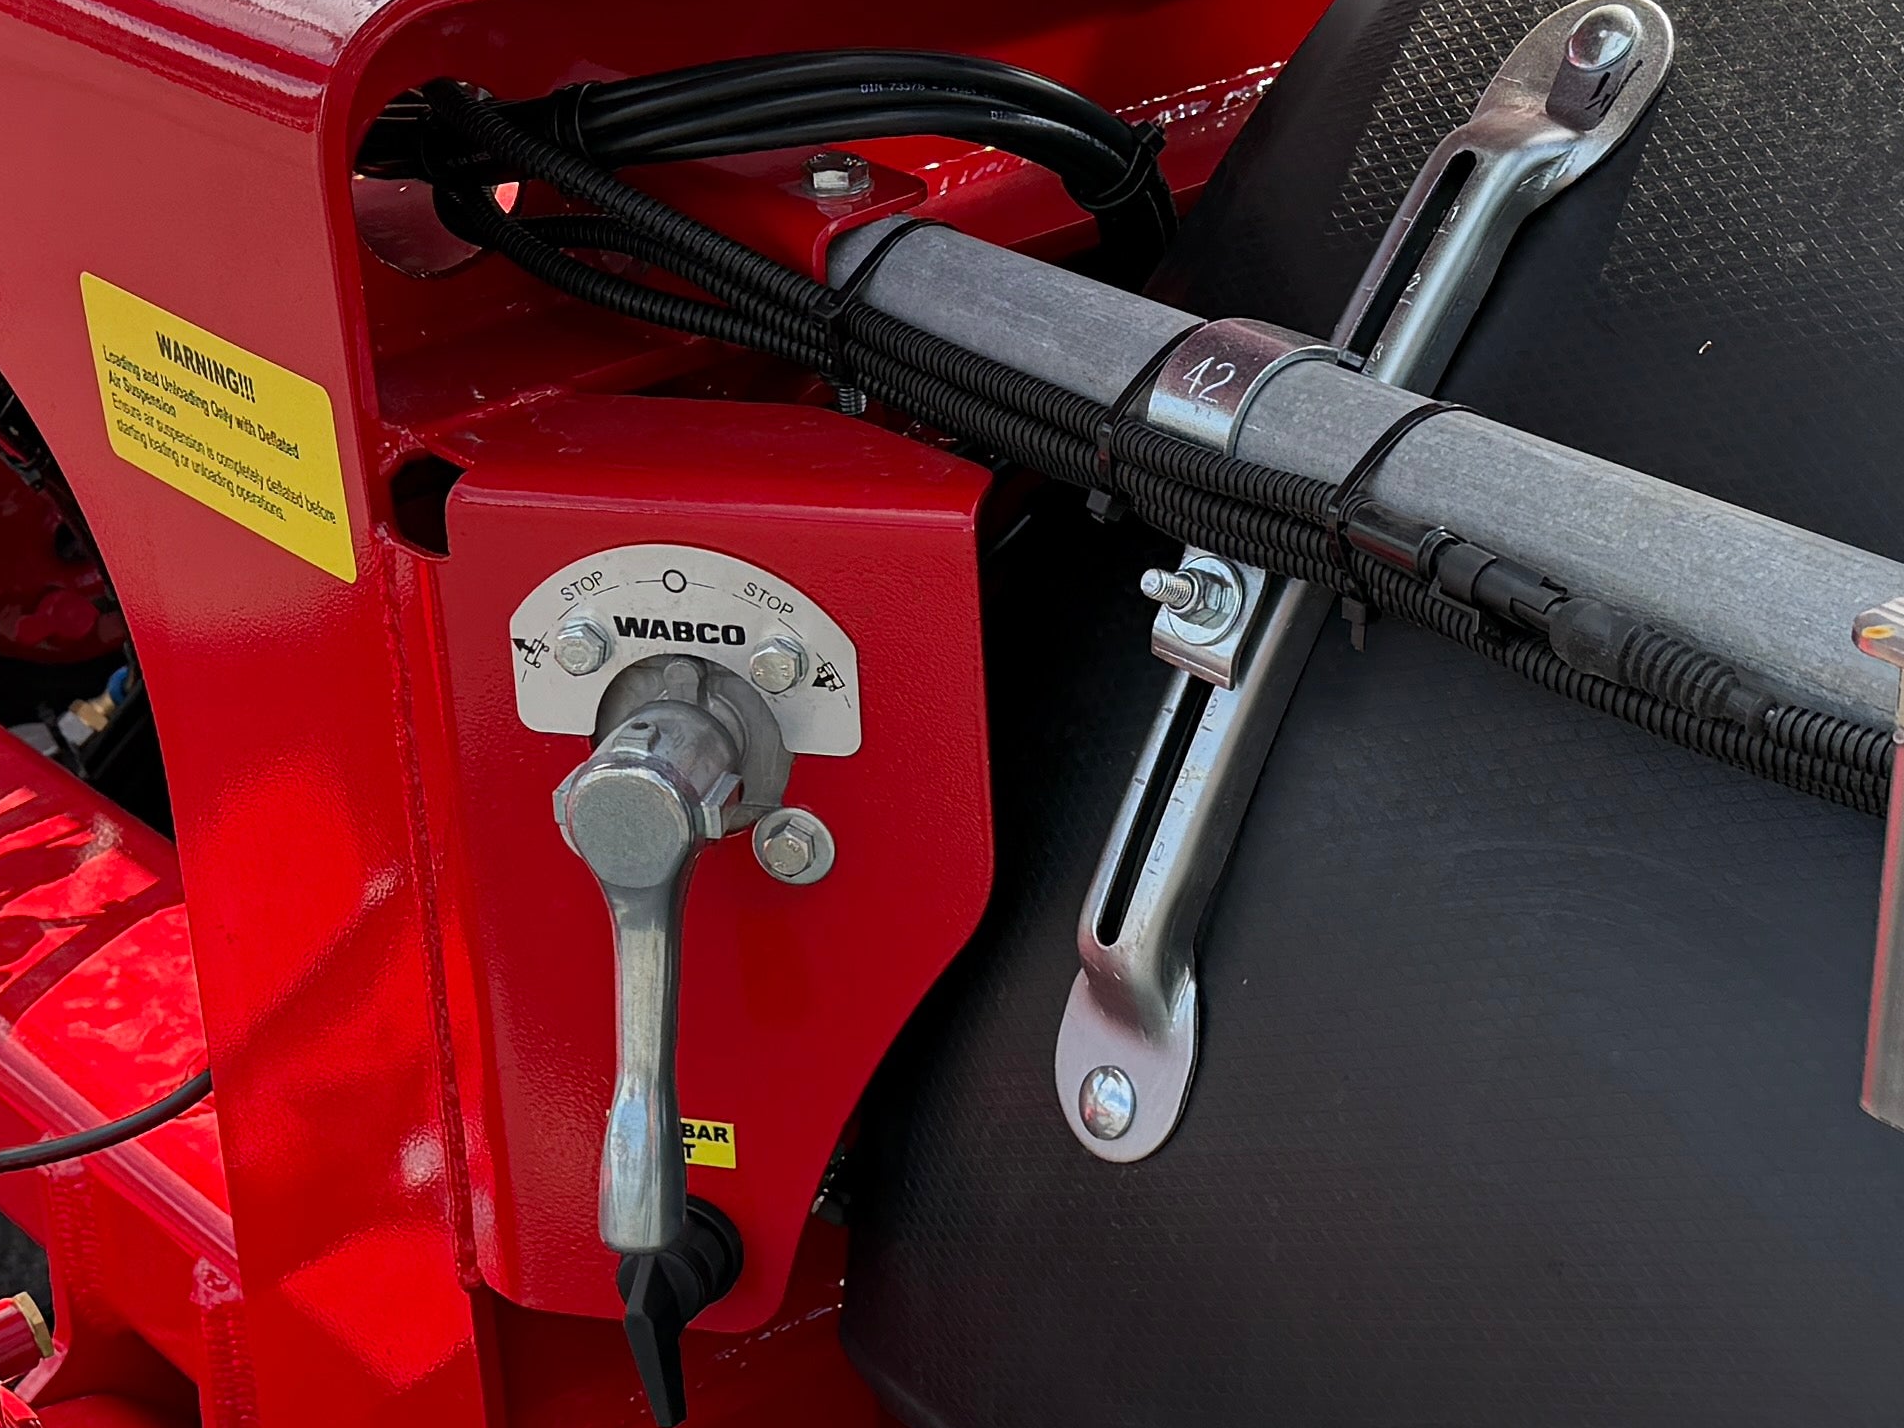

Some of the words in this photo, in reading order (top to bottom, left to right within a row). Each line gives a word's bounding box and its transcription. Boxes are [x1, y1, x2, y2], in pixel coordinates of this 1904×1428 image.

[109, 369, 122, 390] Air
[122, 376, 177, 418] Suspension
[156, 330, 256, 404] WARNING!!!
[103, 344, 142, 382] Loading
[142, 368, 160, 388] and
[161, 373, 210, 418] Unloading
[211, 399, 234, 430] Only
[234, 415, 257, 439] with
[257, 422, 300, 460] Deflated
[156, 418, 206, 456] suspension
[216, 451, 264, 491] completely
[266, 474, 304, 509] deflated
[304, 494, 337, 525] before
[560, 569, 604, 602] STOP
[743, 581, 795, 616] STOP
[613, 615, 747, 646] WABCO
